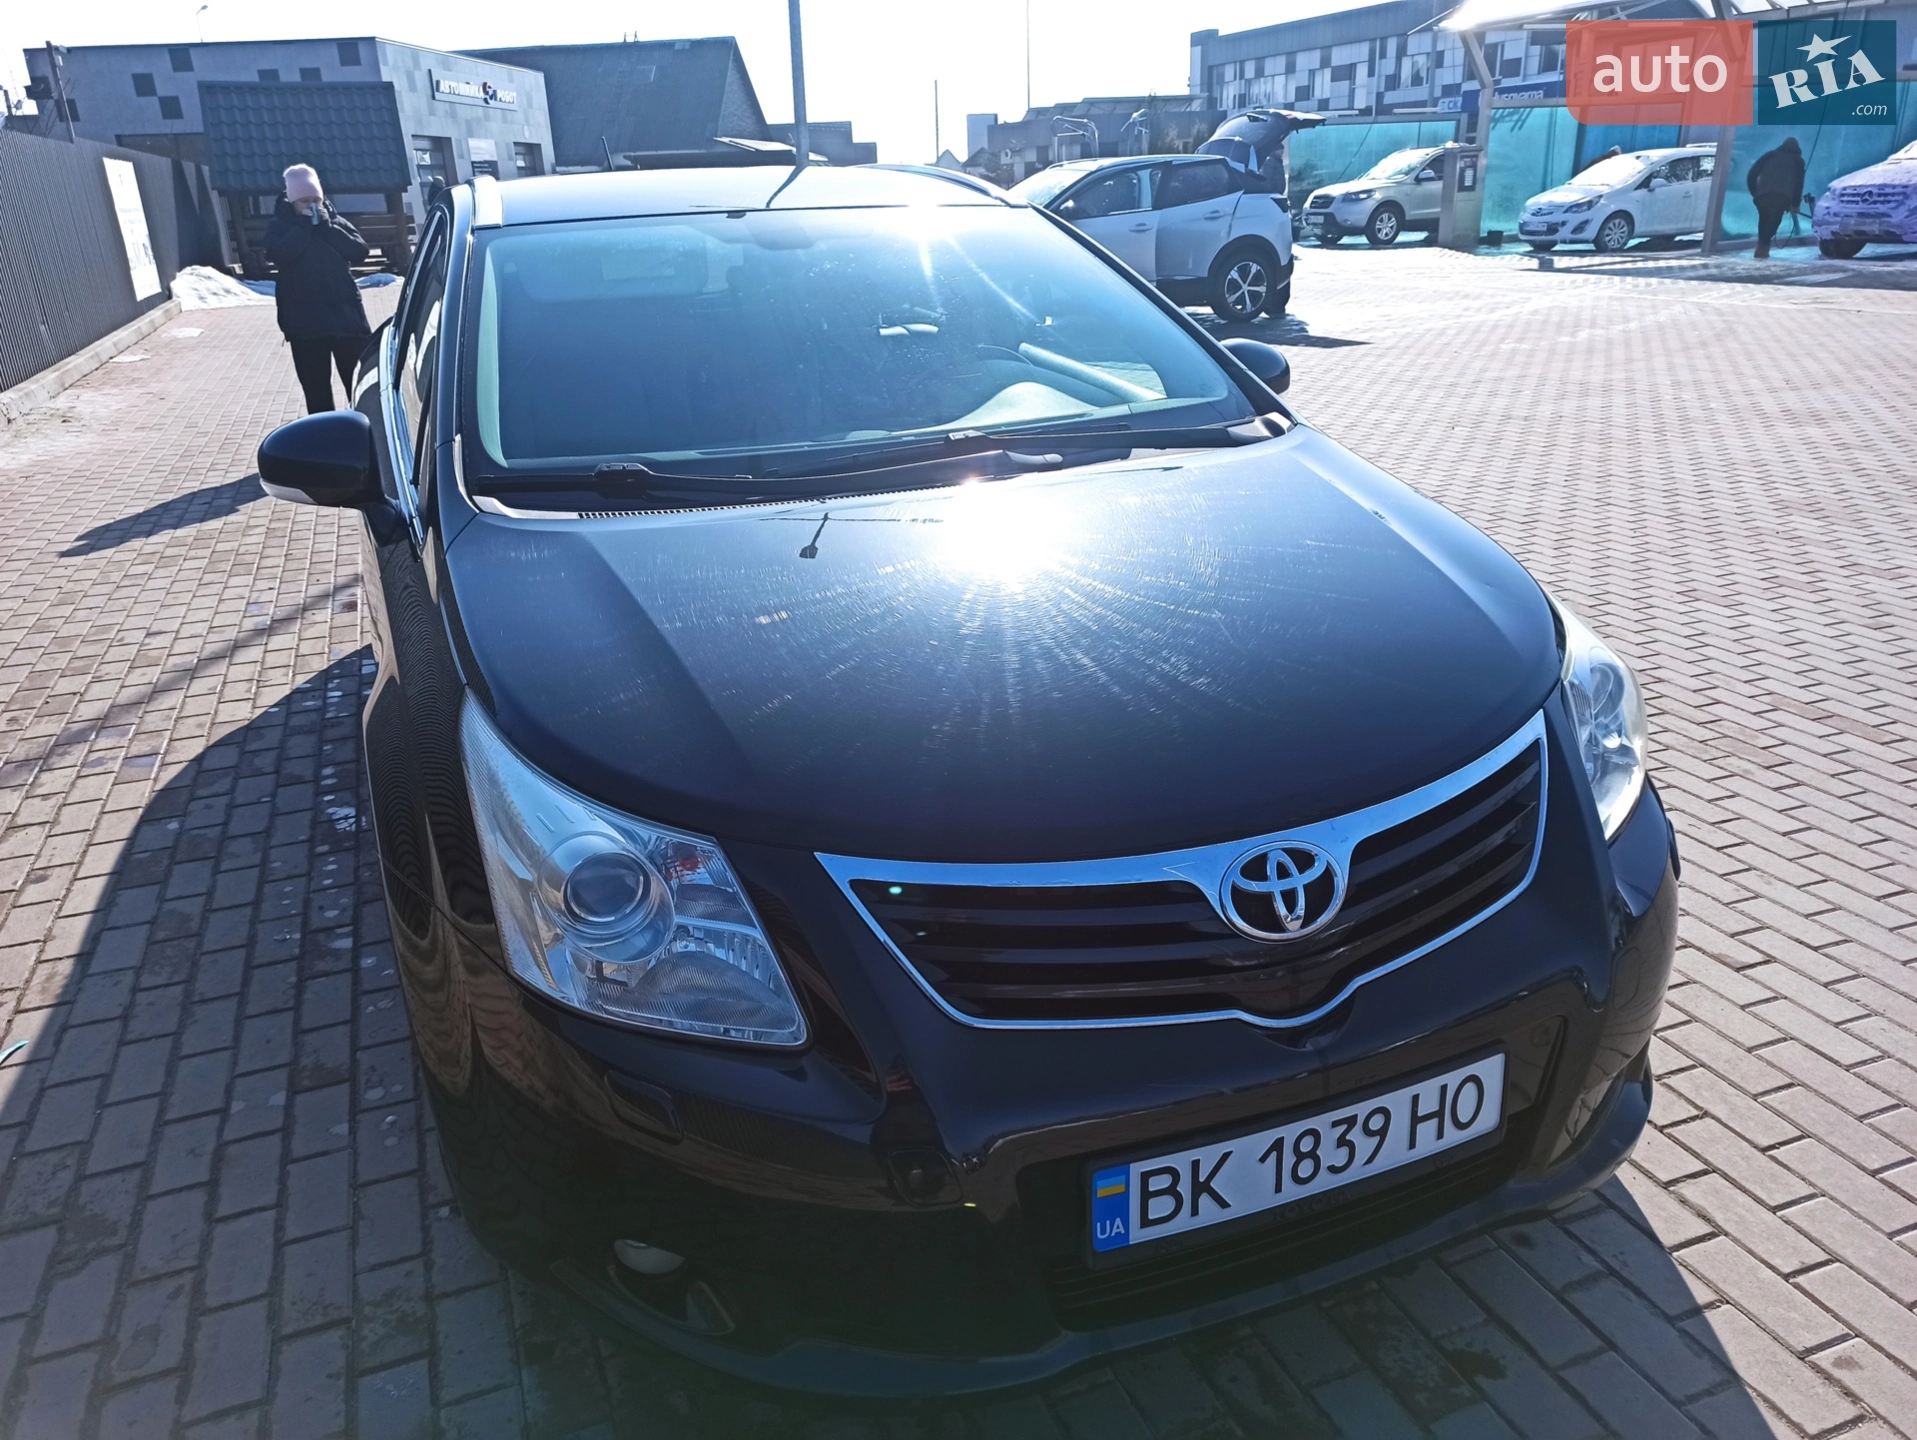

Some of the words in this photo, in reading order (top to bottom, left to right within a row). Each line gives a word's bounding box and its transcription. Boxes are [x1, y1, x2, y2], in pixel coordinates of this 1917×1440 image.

[439, 79, 484, 98] АВТОМИЙКА
[497, 89, 518, 104] РОБОТ
[1139, 1150, 1234, 1229] BK
[1258, 1105, 1393, 1195] 1839
[1408, 1073, 1486, 1151] HO
[1273, 1189, 1352, 1222] TOYOTA
[1096, 1218, 1126, 1240] UA
